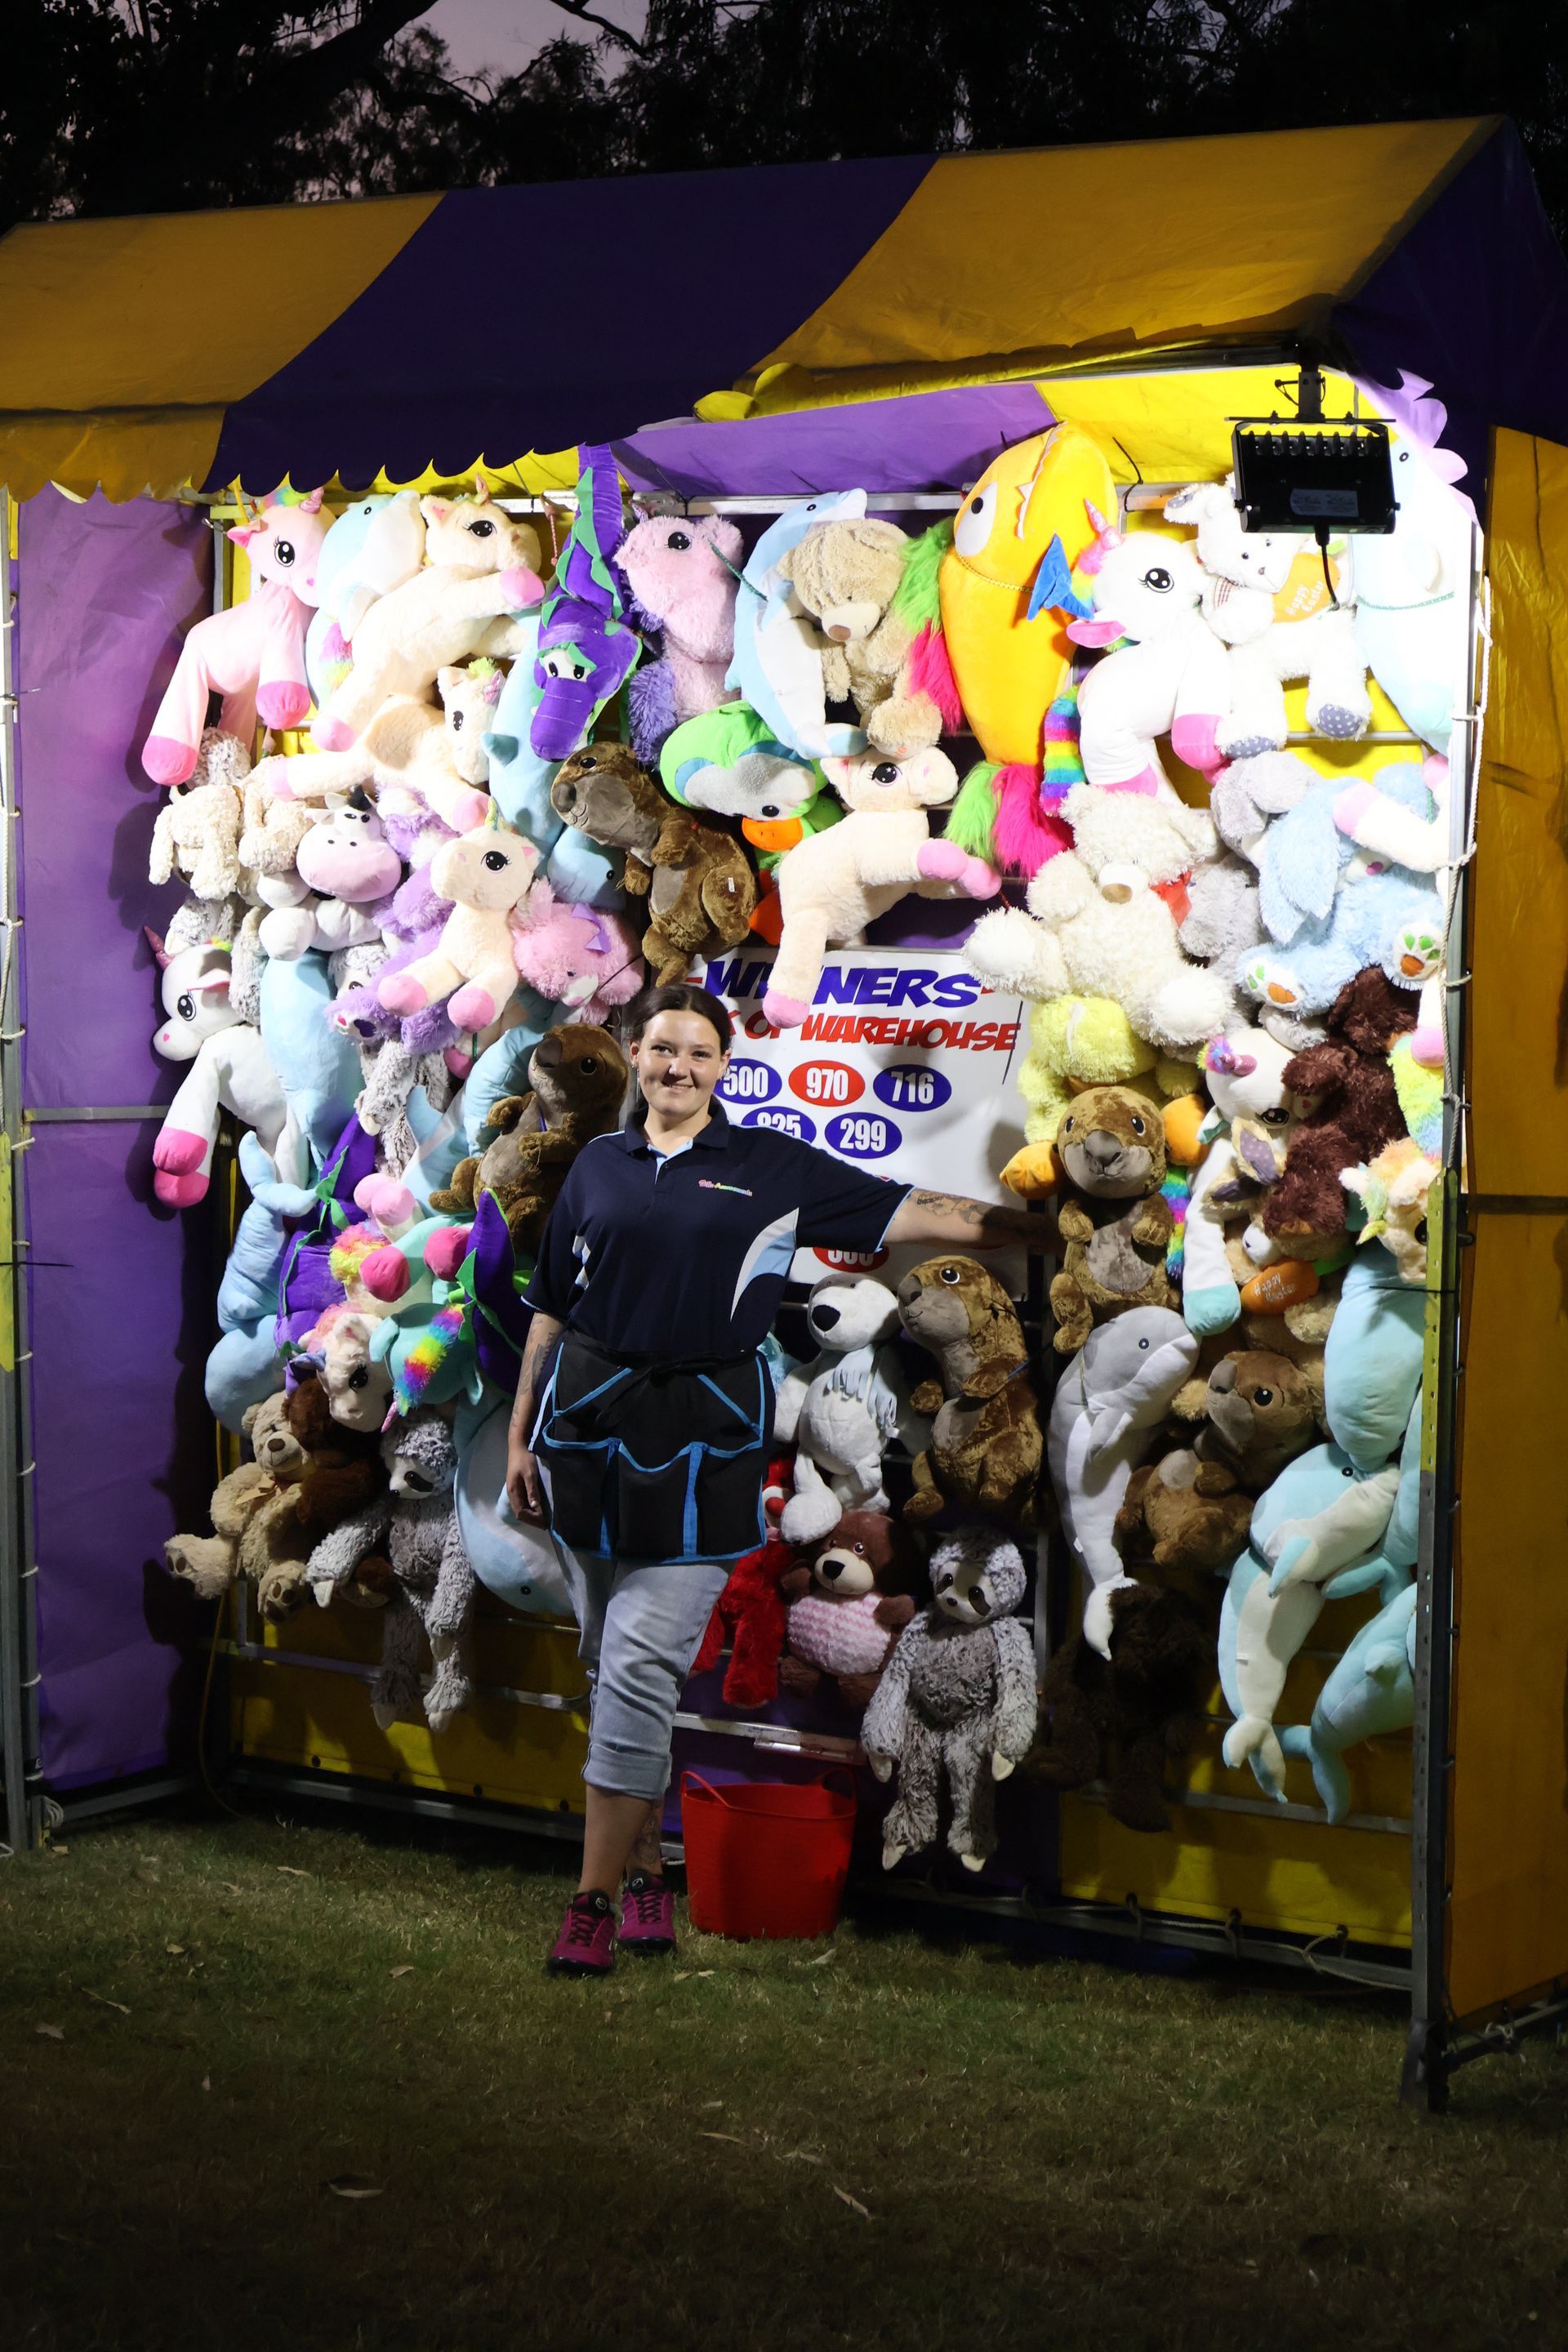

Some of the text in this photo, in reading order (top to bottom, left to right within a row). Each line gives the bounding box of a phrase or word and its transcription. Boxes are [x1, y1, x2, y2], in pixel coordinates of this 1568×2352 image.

[705, 958, 981, 1008] WINERS
[800, 1013, 1021, 1051] WAREHOUSE
[723, 1065, 769, 1098] 500
[805, 1067, 849, 1101] 970
[891, 1071, 935, 1104] 716
[840, 1117, 887, 1152] 299
[1254, 1272, 1281, 1296] Happy
